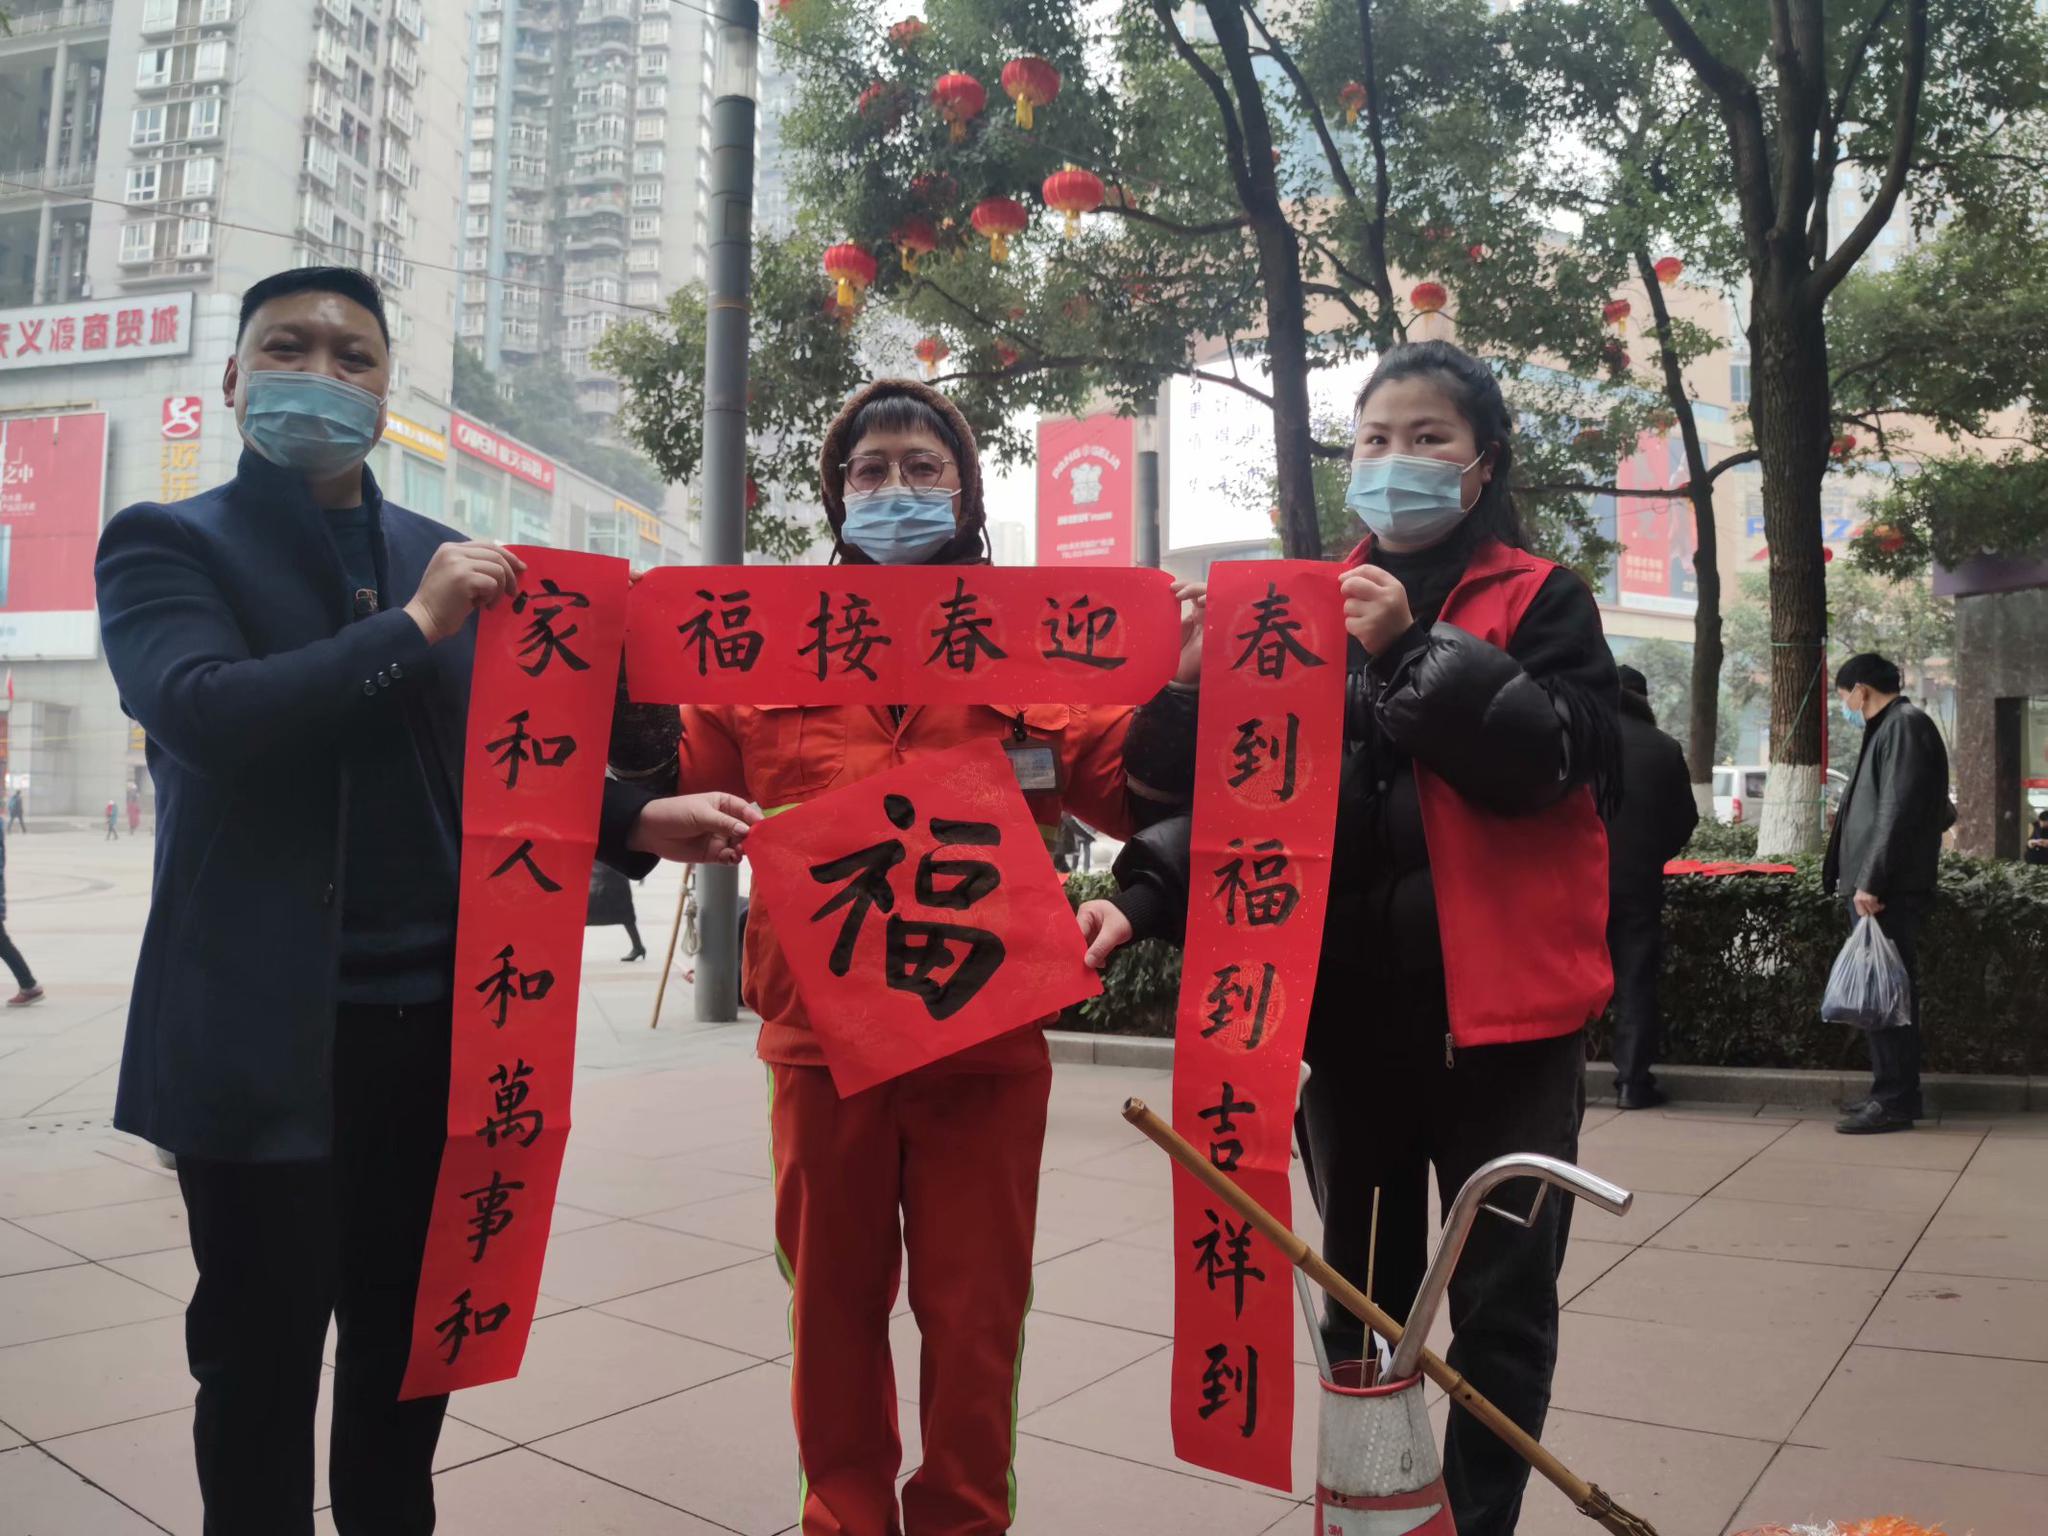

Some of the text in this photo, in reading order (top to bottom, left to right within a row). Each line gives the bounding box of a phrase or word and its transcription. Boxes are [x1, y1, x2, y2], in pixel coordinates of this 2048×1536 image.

[435, 579, 592, 1367] 家和人和萬事和
[809, 793, 1007, 1022] 福
[1193, 581, 1328, 1440] 春到福到吉祥到
